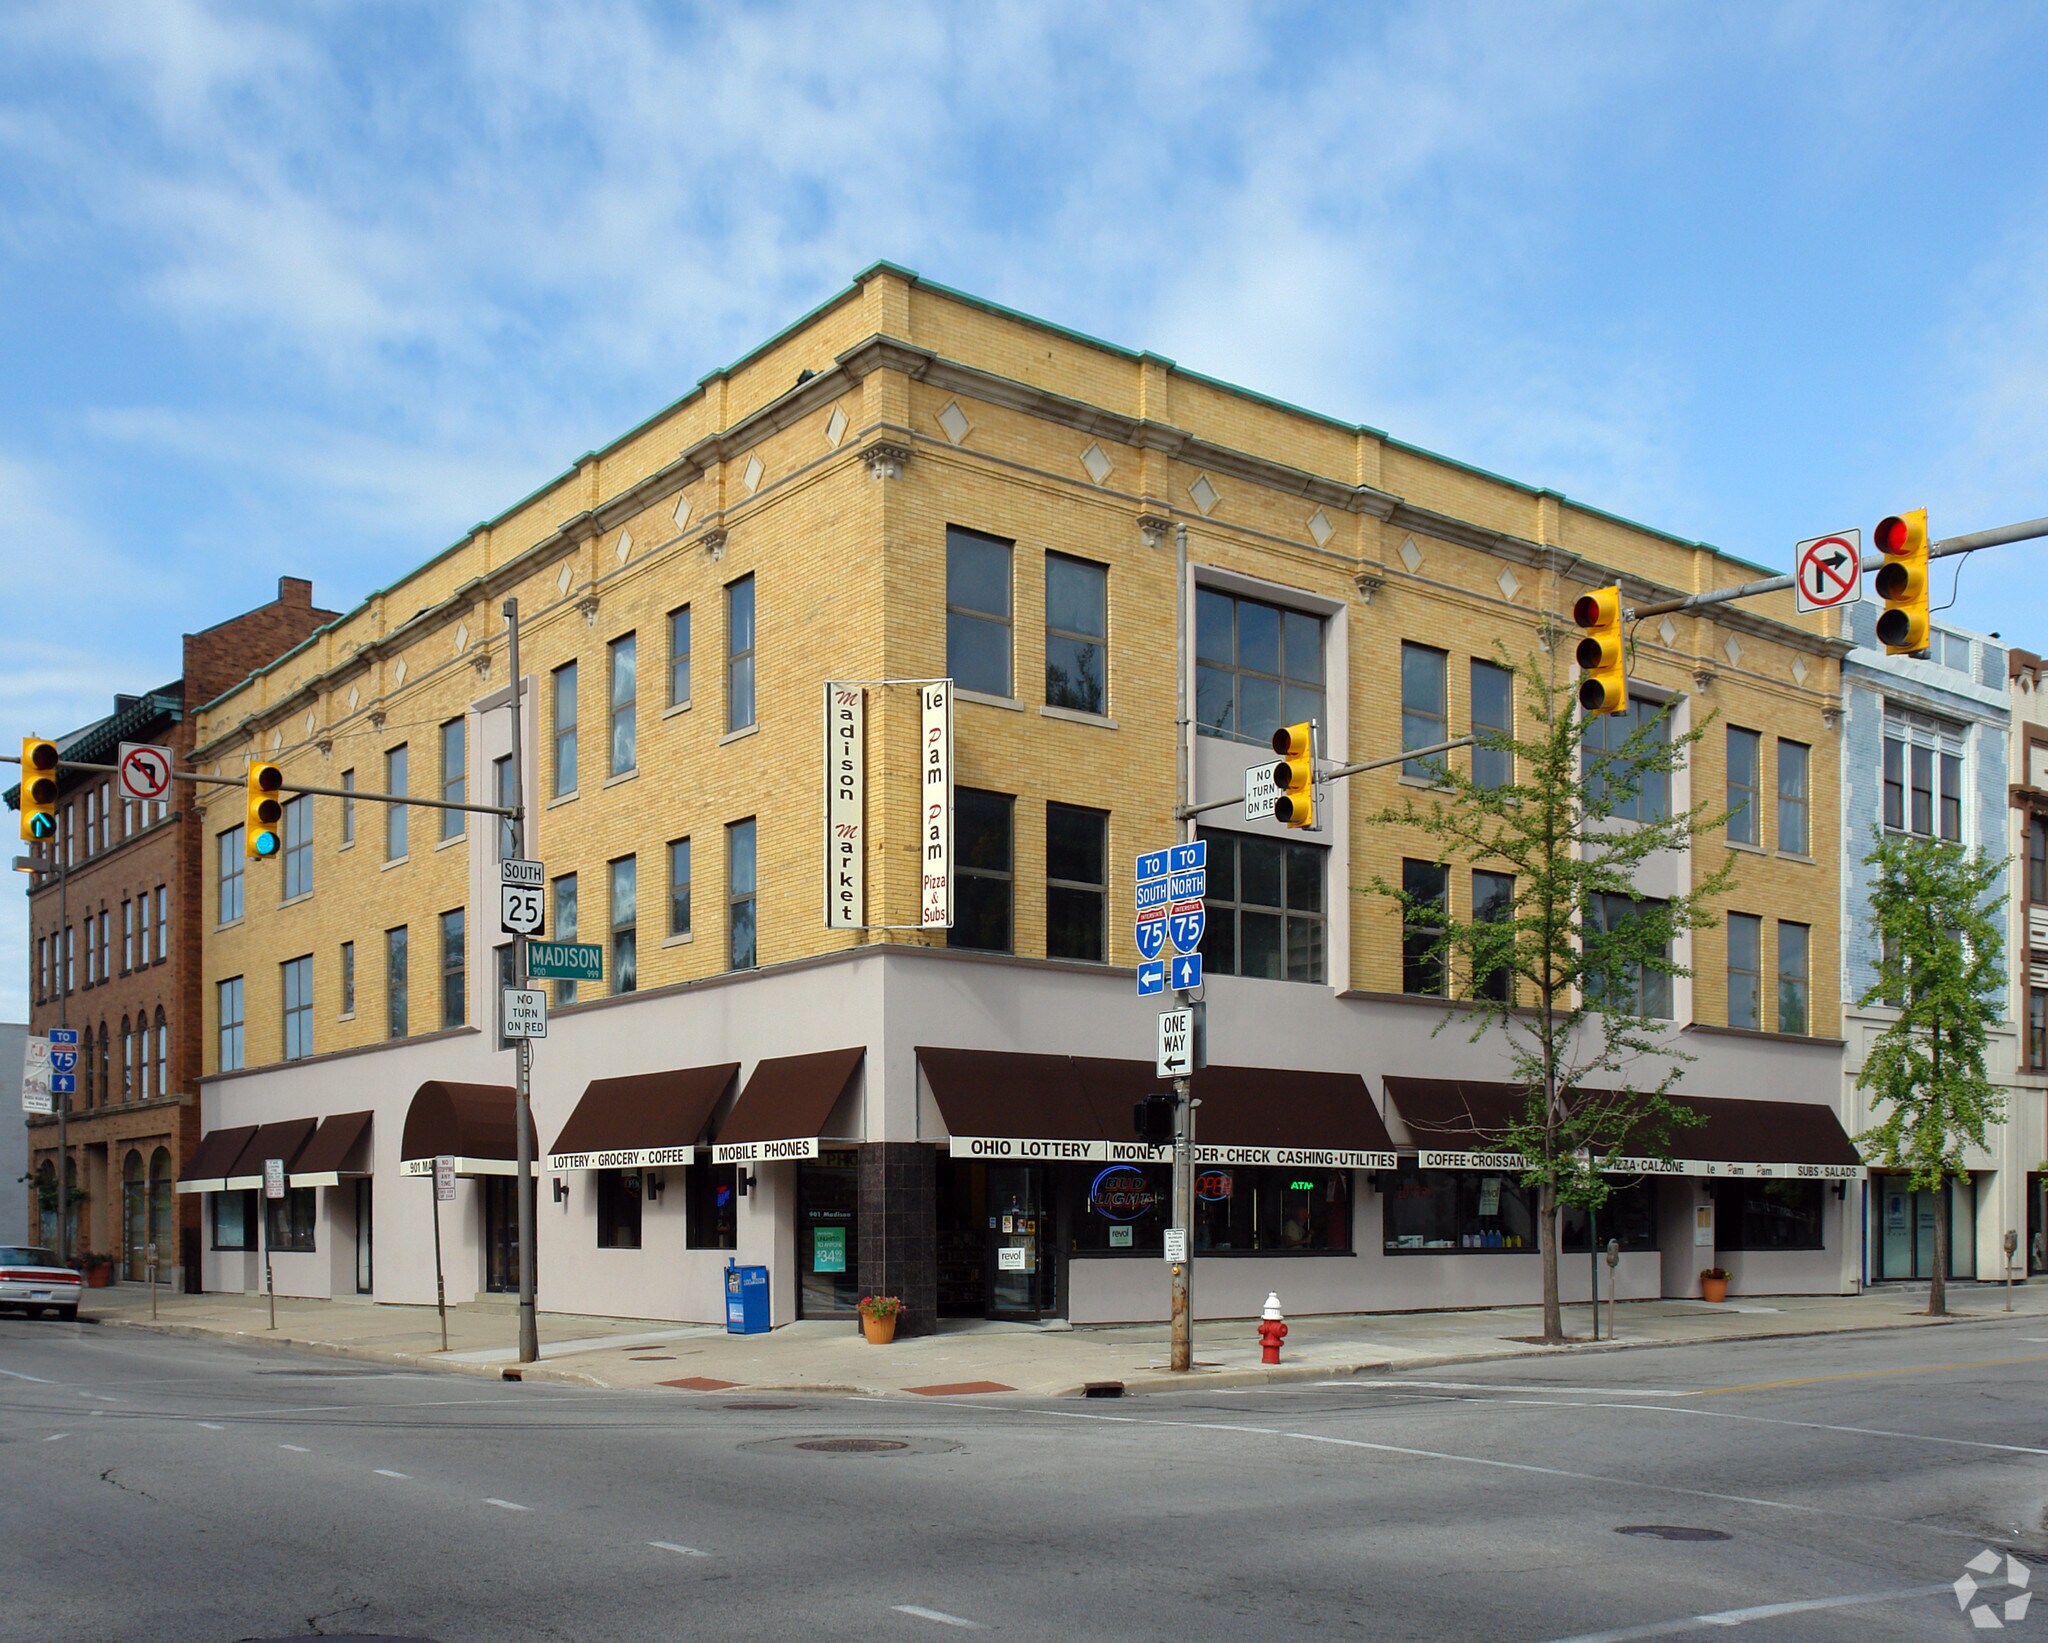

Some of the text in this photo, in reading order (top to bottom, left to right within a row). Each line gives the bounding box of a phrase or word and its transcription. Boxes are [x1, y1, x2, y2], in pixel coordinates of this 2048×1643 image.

[926, 692, 943, 861] le Pam Pam
[1256, 769, 1271, 781] NO
[1253, 783, 1275, 797] TURN
[835, 690, 858, 921] Madison Market
[1248, 802, 1260, 813] ON
[1180, 849, 1196, 866] TO
[504, 862, 542, 881] SOUTH
[1145, 858, 1160, 874] TO
[924, 874, 946, 890] Pizza
[1171, 875, 1204, 896] NORTH
[1137, 883, 1167, 905] SOUTH
[508, 895, 538, 923] 25
[924, 906, 946, 923] Subs
[1140, 922, 1163, 948] 75
[1174, 915, 1200, 942] 75
[532, 945, 600, 969] MADISON
[533, 967, 546, 976] 900
[517, 995, 533, 1005] NO
[513, 1008, 538, 1019] TURN
[507, 1021, 544, 1032] ON RED
[1164, 1015, 1186, 1034] ONE
[56, 1032, 70, 1041] TO
[1164, 1034, 1186, 1052] WAY
[54, 1052, 74, 1067] 75
[553, 1148, 684, 1169] LOTTERY GROCERY COFFEE
[718, 1140, 810, 1161] MOBILE PHONES
[971, 1140, 1396, 1167] OHIO LOTTERY MONEY DER CHECK CASHING UTILITIES
[410, 1162, 421, 1173] 901
[1426, 1153, 1467, 1167] COFFEE
[1641, 1160, 1684, 1173] CALZONE
[1707, 1163, 1773, 1177] le Pam Pam
[1797, 1165, 1857, 1178] SUBS SALADS
[1105, 1177, 1148, 1191] BUD
[1195, 1177, 1233, 1196] OPEN
[1290, 1181, 1314, 1190] ATM
[1094, 1192, 1150, 1208] LIGHT
[1112, 1228, 1129, 1238] revol
[1001, 1251, 1021, 1260] revol
